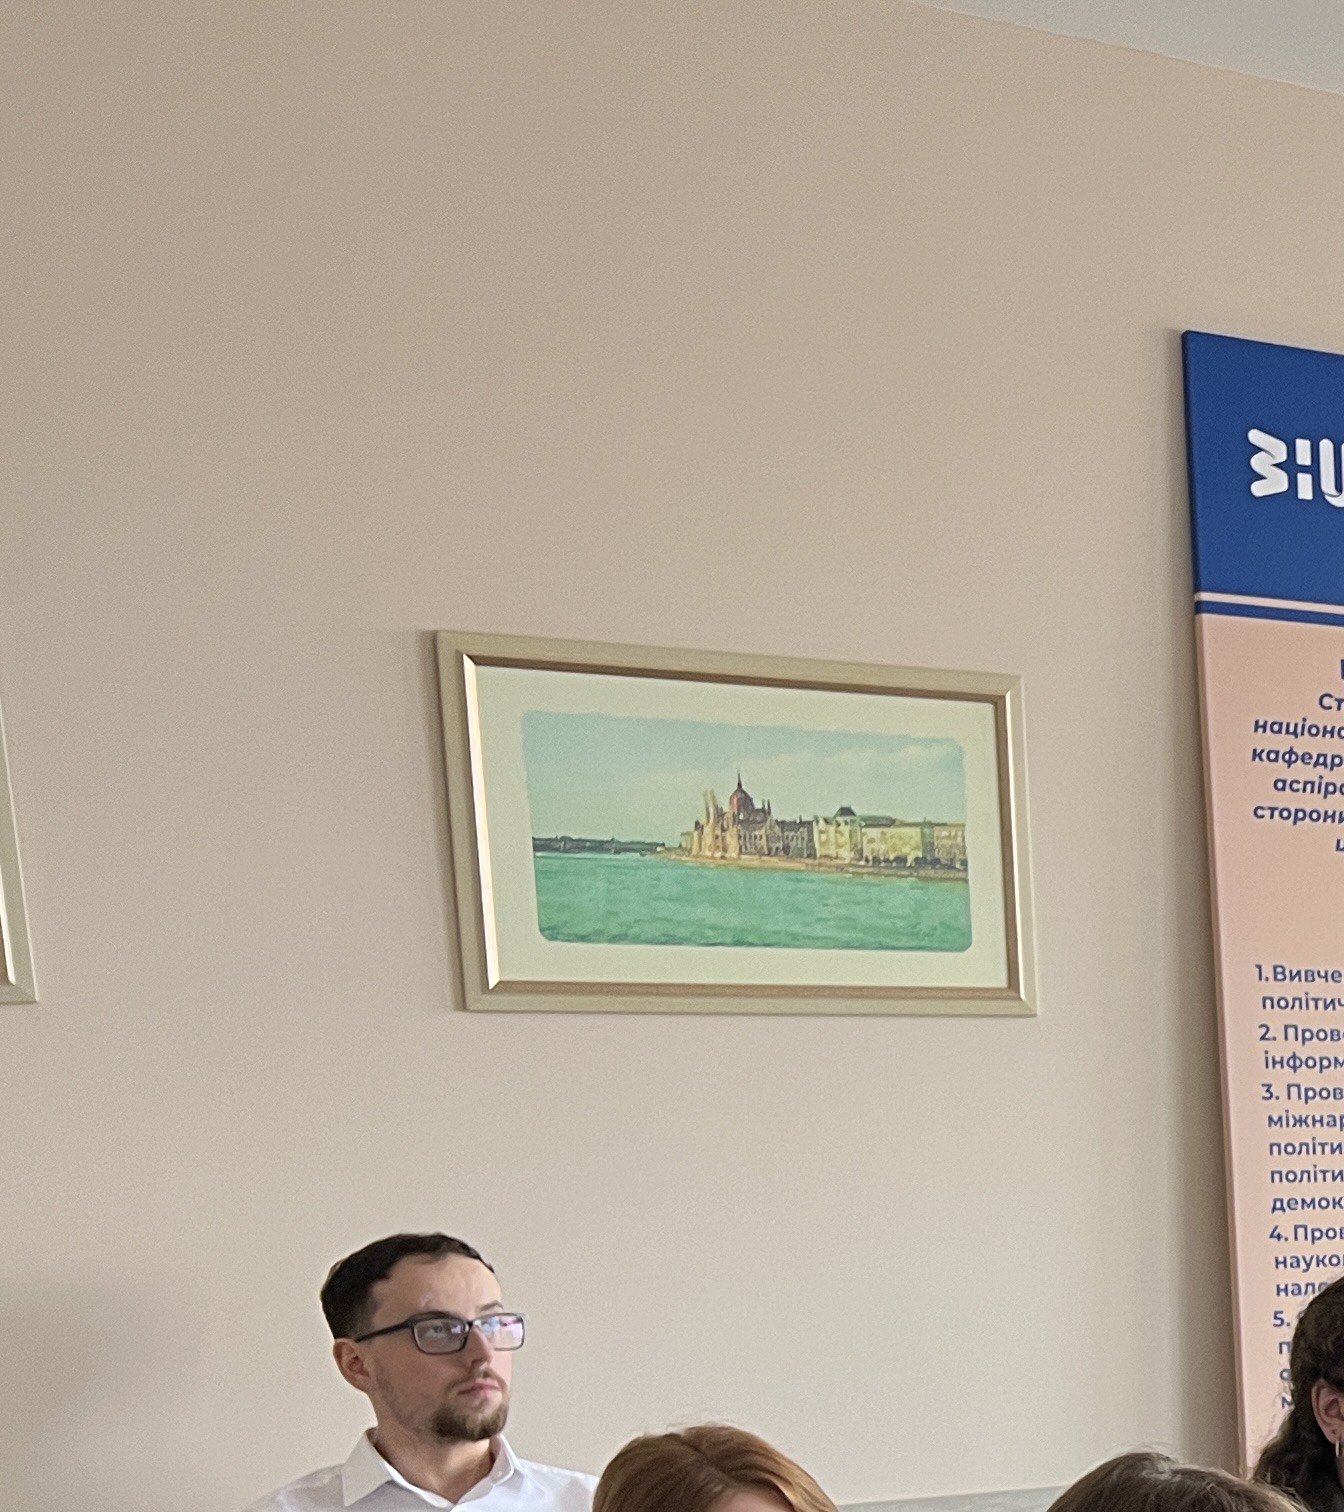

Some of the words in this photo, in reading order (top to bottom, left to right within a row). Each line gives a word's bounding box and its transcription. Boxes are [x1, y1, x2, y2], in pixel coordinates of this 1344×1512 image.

[1258, 1023, 1277, 1041] 2.
[1261, 1083, 1280, 1101] 3.
[1273, 1310, 1291, 1328] 5.
